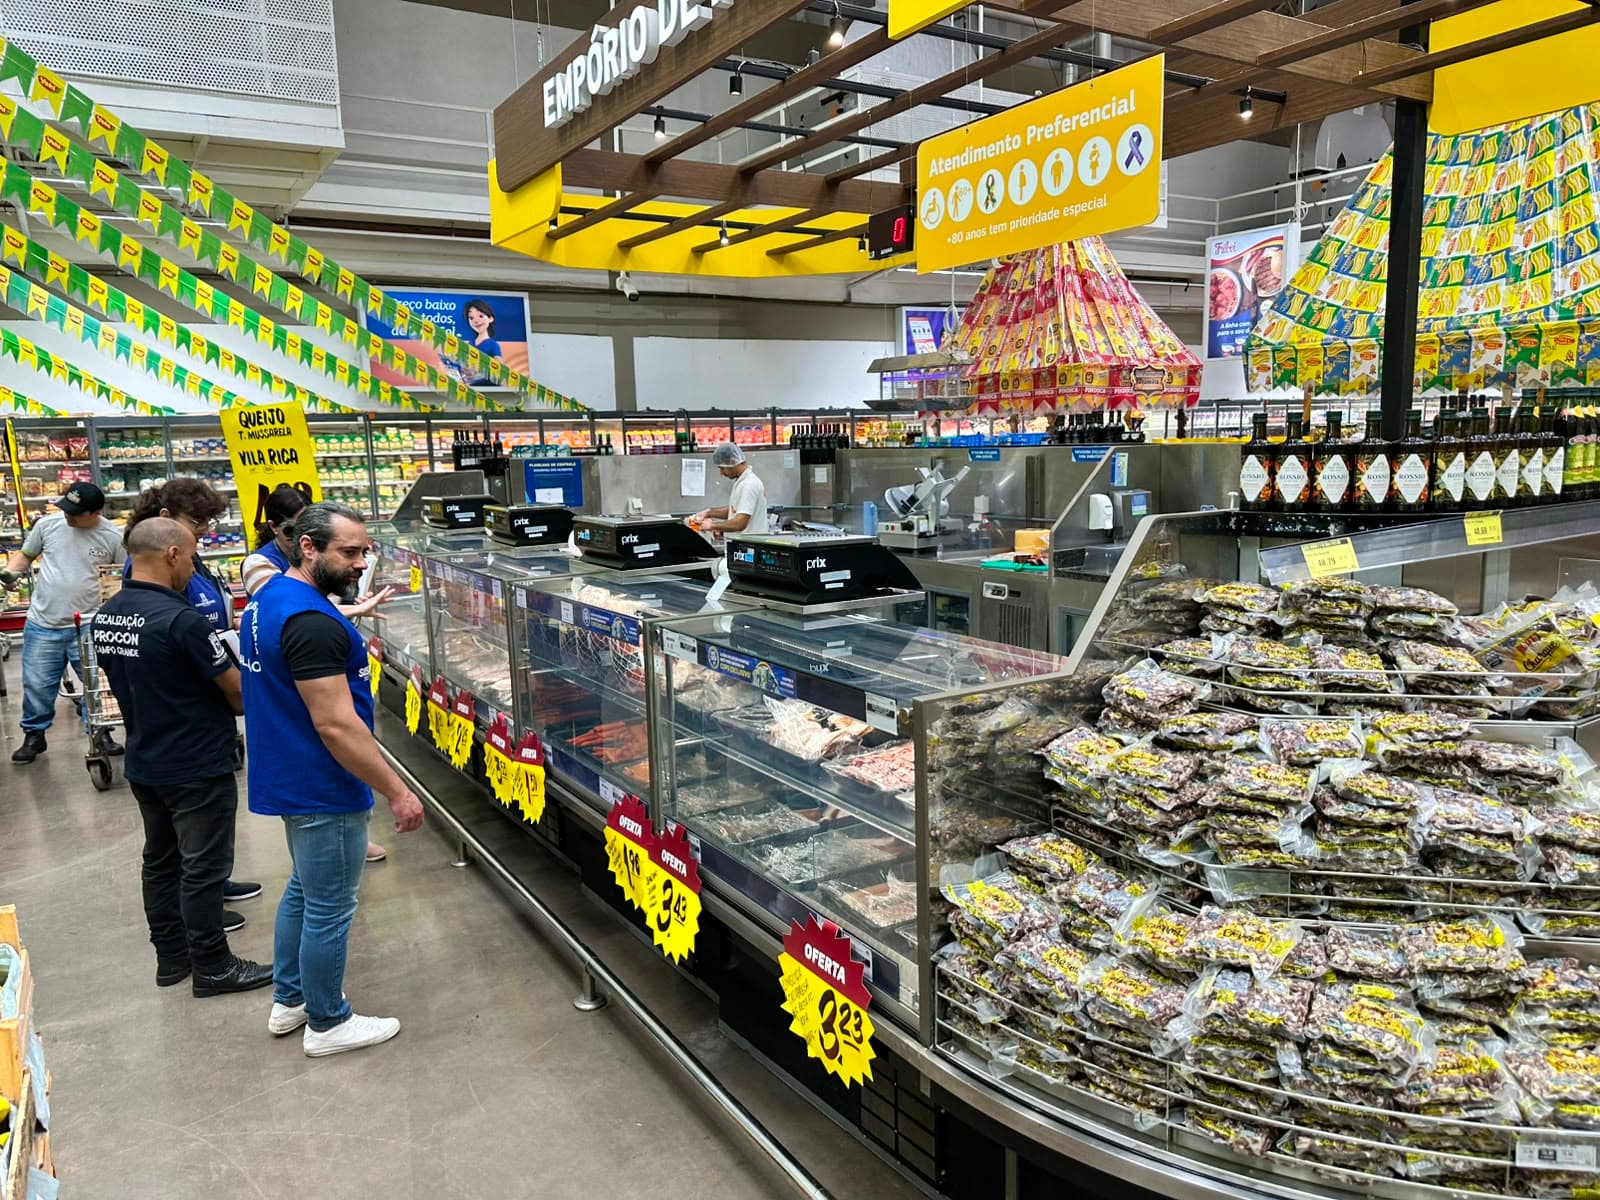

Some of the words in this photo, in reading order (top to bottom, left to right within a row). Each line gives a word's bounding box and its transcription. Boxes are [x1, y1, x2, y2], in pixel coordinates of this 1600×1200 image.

[543, 5, 654, 129] EMPÓRIO
[929, 133, 1021, 177] Atendimento
[1027, 90, 1136, 145] Preferencial
[947, 231, 964, 244] +80
[966, 229, 987, 241] anos
[989, 223, 1007, 236] tem
[1010, 208, 1060, 233] prioridade
[1063, 194, 1107, 217] especial
[425, 298, 457, 311] baixo
[238, 407, 285, 429] QUEIJO
[248, 427, 292, 440] MUSSARELA
[238, 449, 266, 466] VILA
[268, 448, 299, 465] RICA
[514, 516, 530, 527] prix
[621, 533, 639, 546] prix
[806, 556, 827, 572] prix
[96, 613, 145, 630] FISCALIZAÇÃO
[94, 629, 139, 646] PROCON
[95, 644, 117, 655] CAMPO
[117, 647, 140, 657] GRANDE
[1523, 640, 1561, 672] Charque
[619, 814, 642, 838] OFERTA
[661, 848, 687, 877] OFERTA
[804, 943, 846, 985] OFERTA
